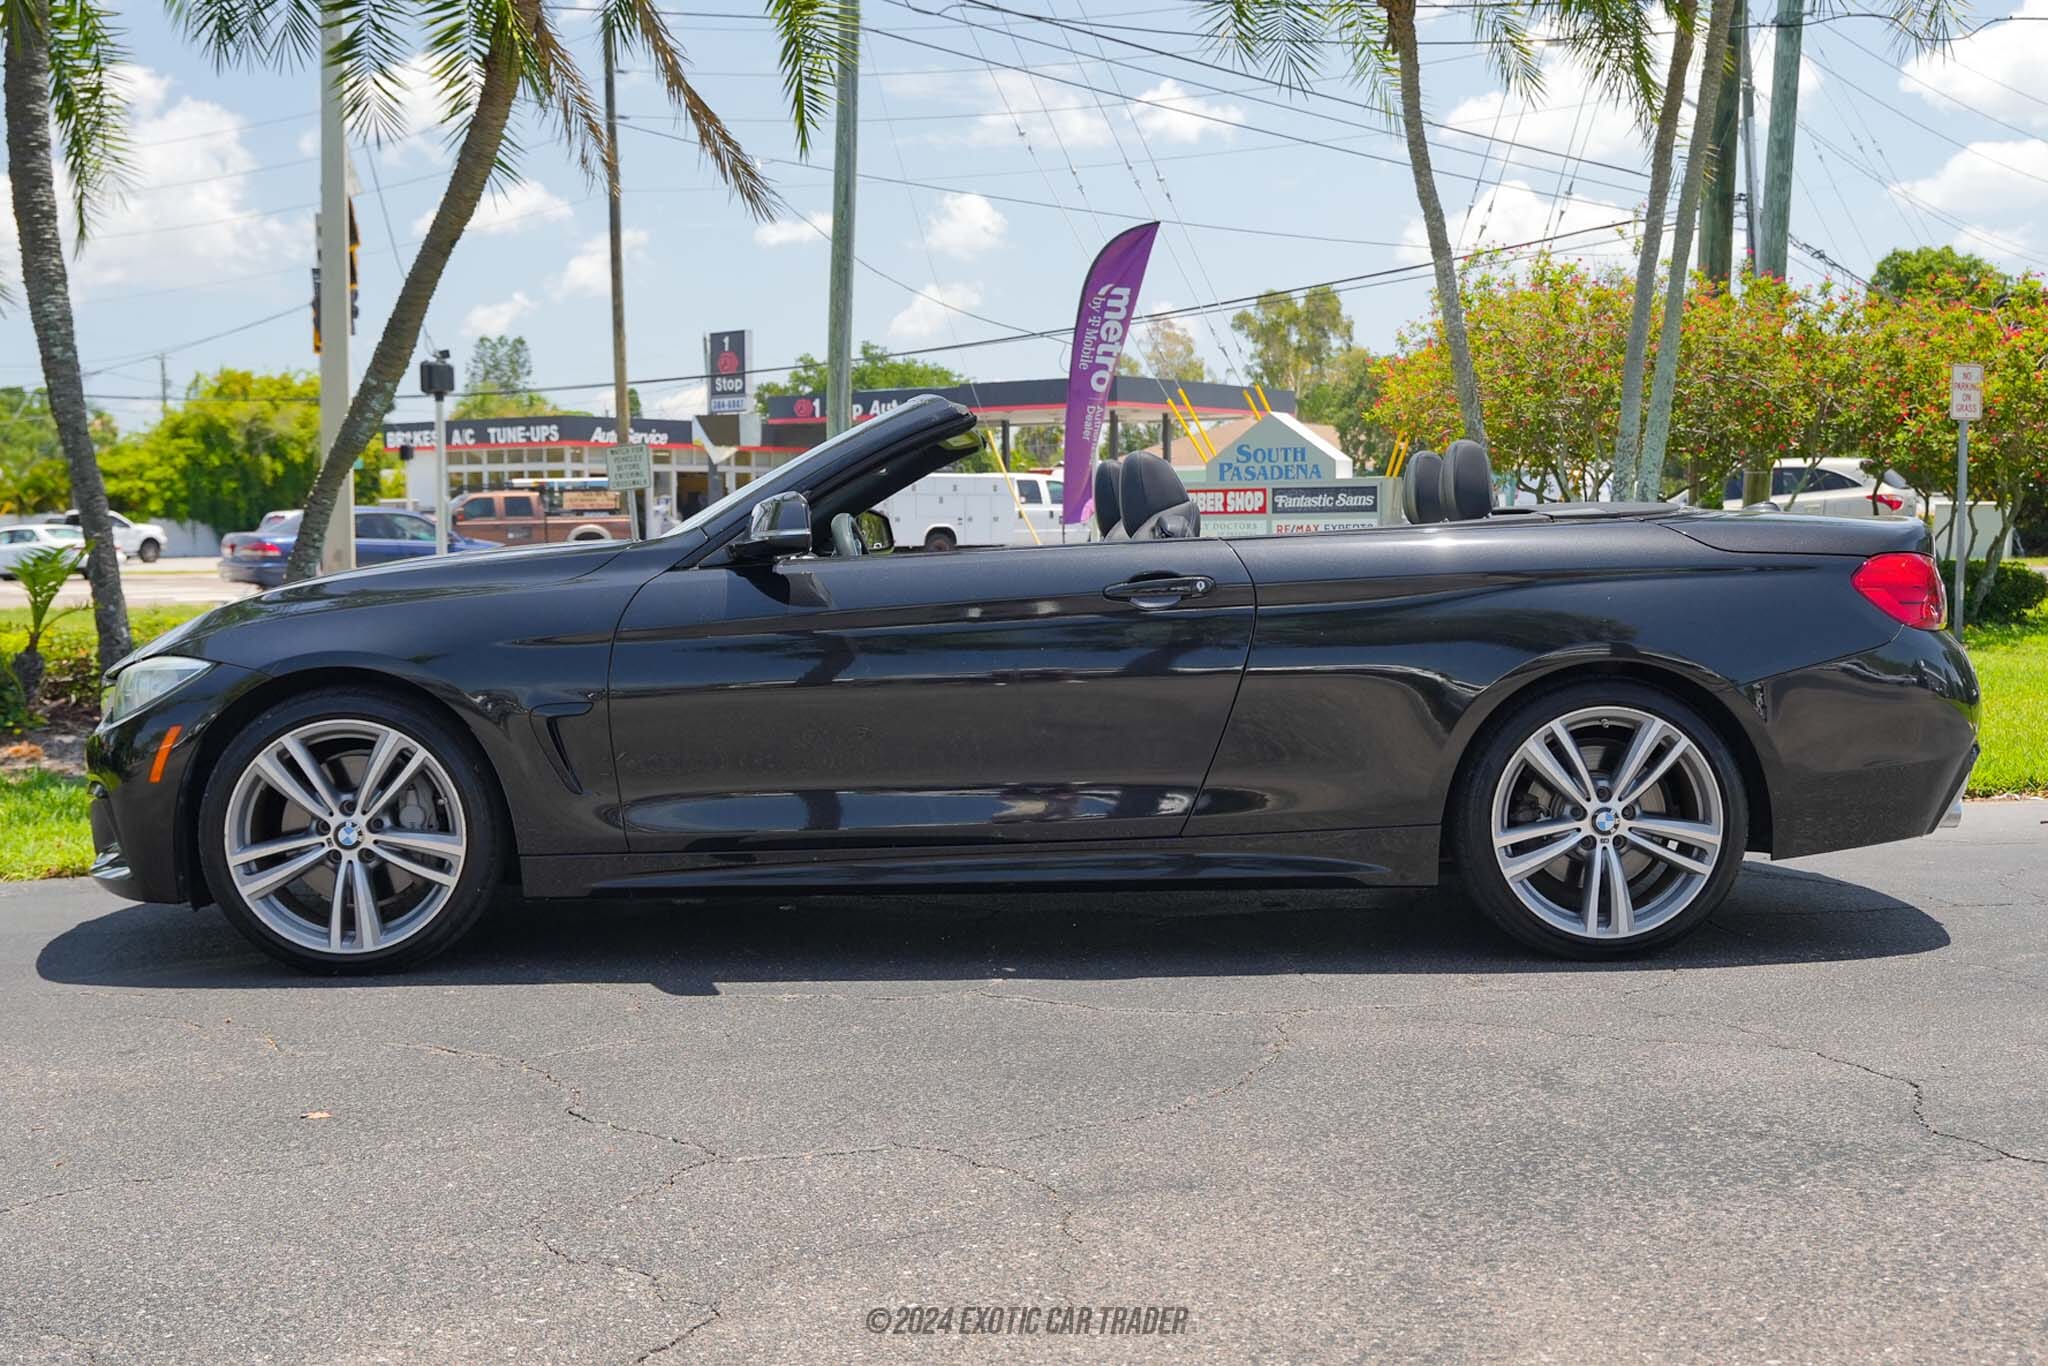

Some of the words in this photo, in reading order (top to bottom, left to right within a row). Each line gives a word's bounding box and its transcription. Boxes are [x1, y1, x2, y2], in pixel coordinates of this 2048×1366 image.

[1088, 295, 1106, 313] by
[723, 336, 730, 352] 1
[1079, 327, 1099, 370] Mobile
[1090, 287, 1131, 393] metro
[715, 377, 743, 392] Stop
[813, 400, 821, 418] 1
[1082, 405, 1096, 440] Dealer
[487, 424, 560, 444] TUNE-UPS
[1236, 444, 1306, 464] SOUTH
[1218, 463, 1323, 482] PASADENA
[1226, 491, 1265, 512] SHOP
[1274, 494, 1334, 508] Fantastic
[1335, 493, 1376, 507] Sams
